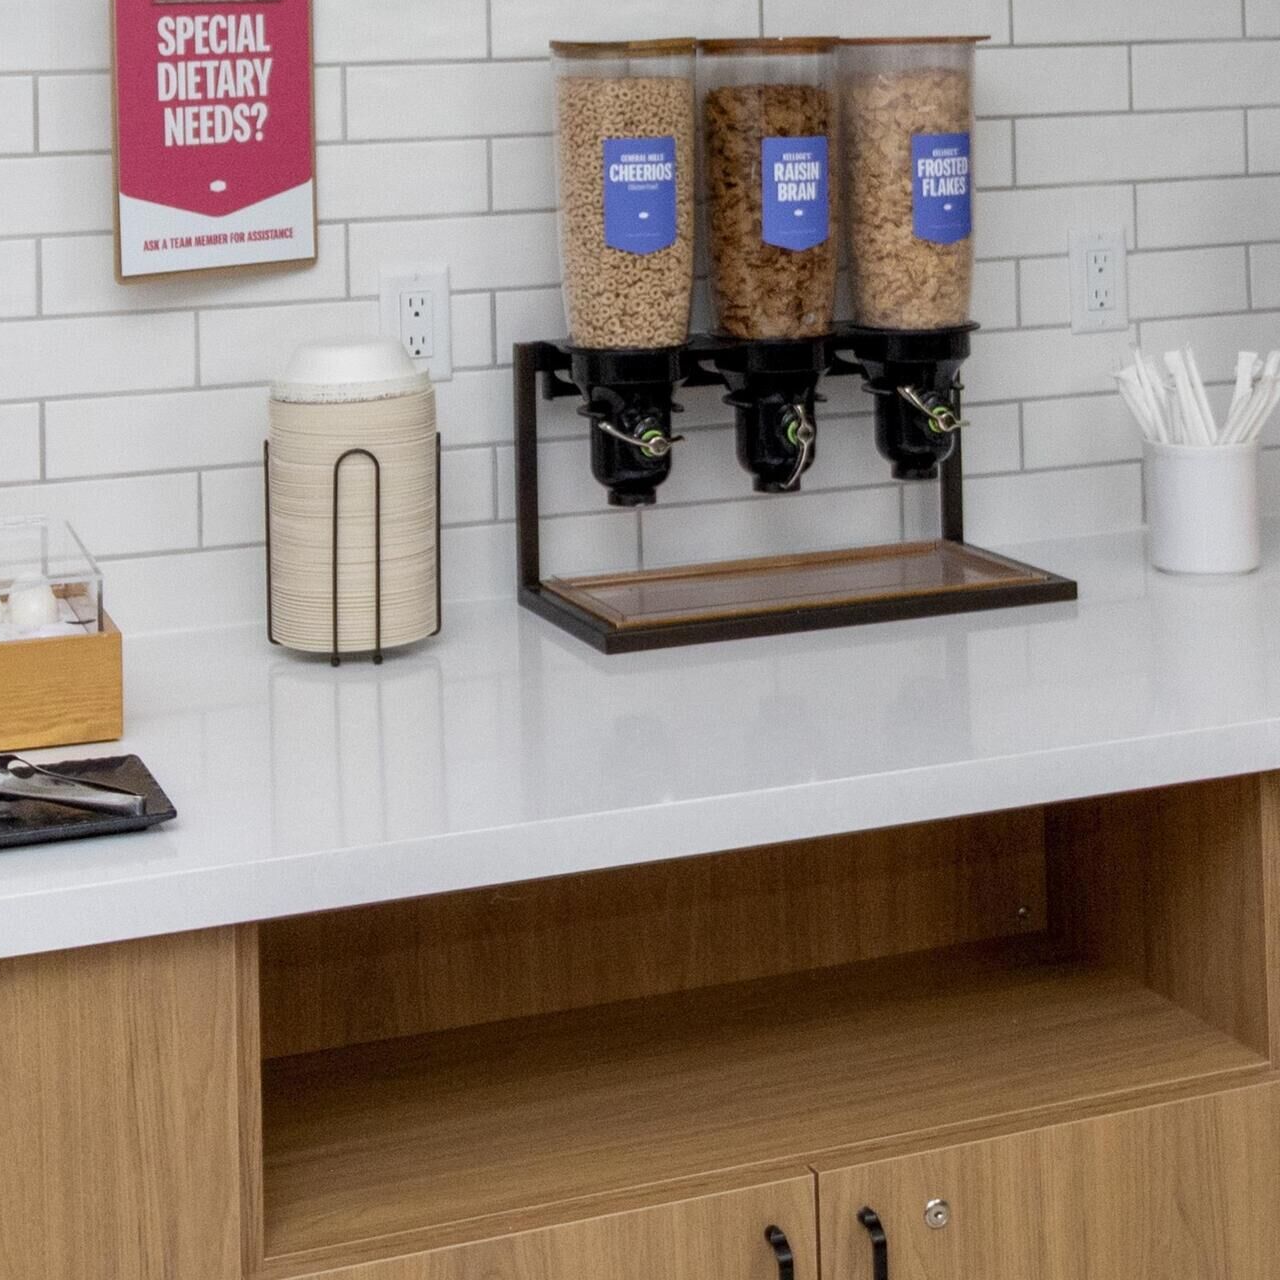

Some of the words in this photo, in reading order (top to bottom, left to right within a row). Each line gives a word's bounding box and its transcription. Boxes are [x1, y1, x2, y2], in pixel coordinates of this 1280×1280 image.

[157, 14, 271, 56] SPECIAL
[157, 58, 272, 102] DIETARY
[164, 102, 268, 147] NEEDS?
[609, 162, 672, 183] CHEERIOS
[774, 161, 820, 182] RAISIN
[917, 157, 969, 177] FROSTED
[777, 181, 816, 202] BRAN
[922, 176, 966, 197] FLAKES
[143, 239, 160, 252] ASK
[162, 238, 168, 250] A
[170, 236, 192, 249] TEAM
[194, 233, 228, 247] MEMBER
[230, 231, 245, 244] FOR
[247, 227, 294, 242] ASSISTANCE
